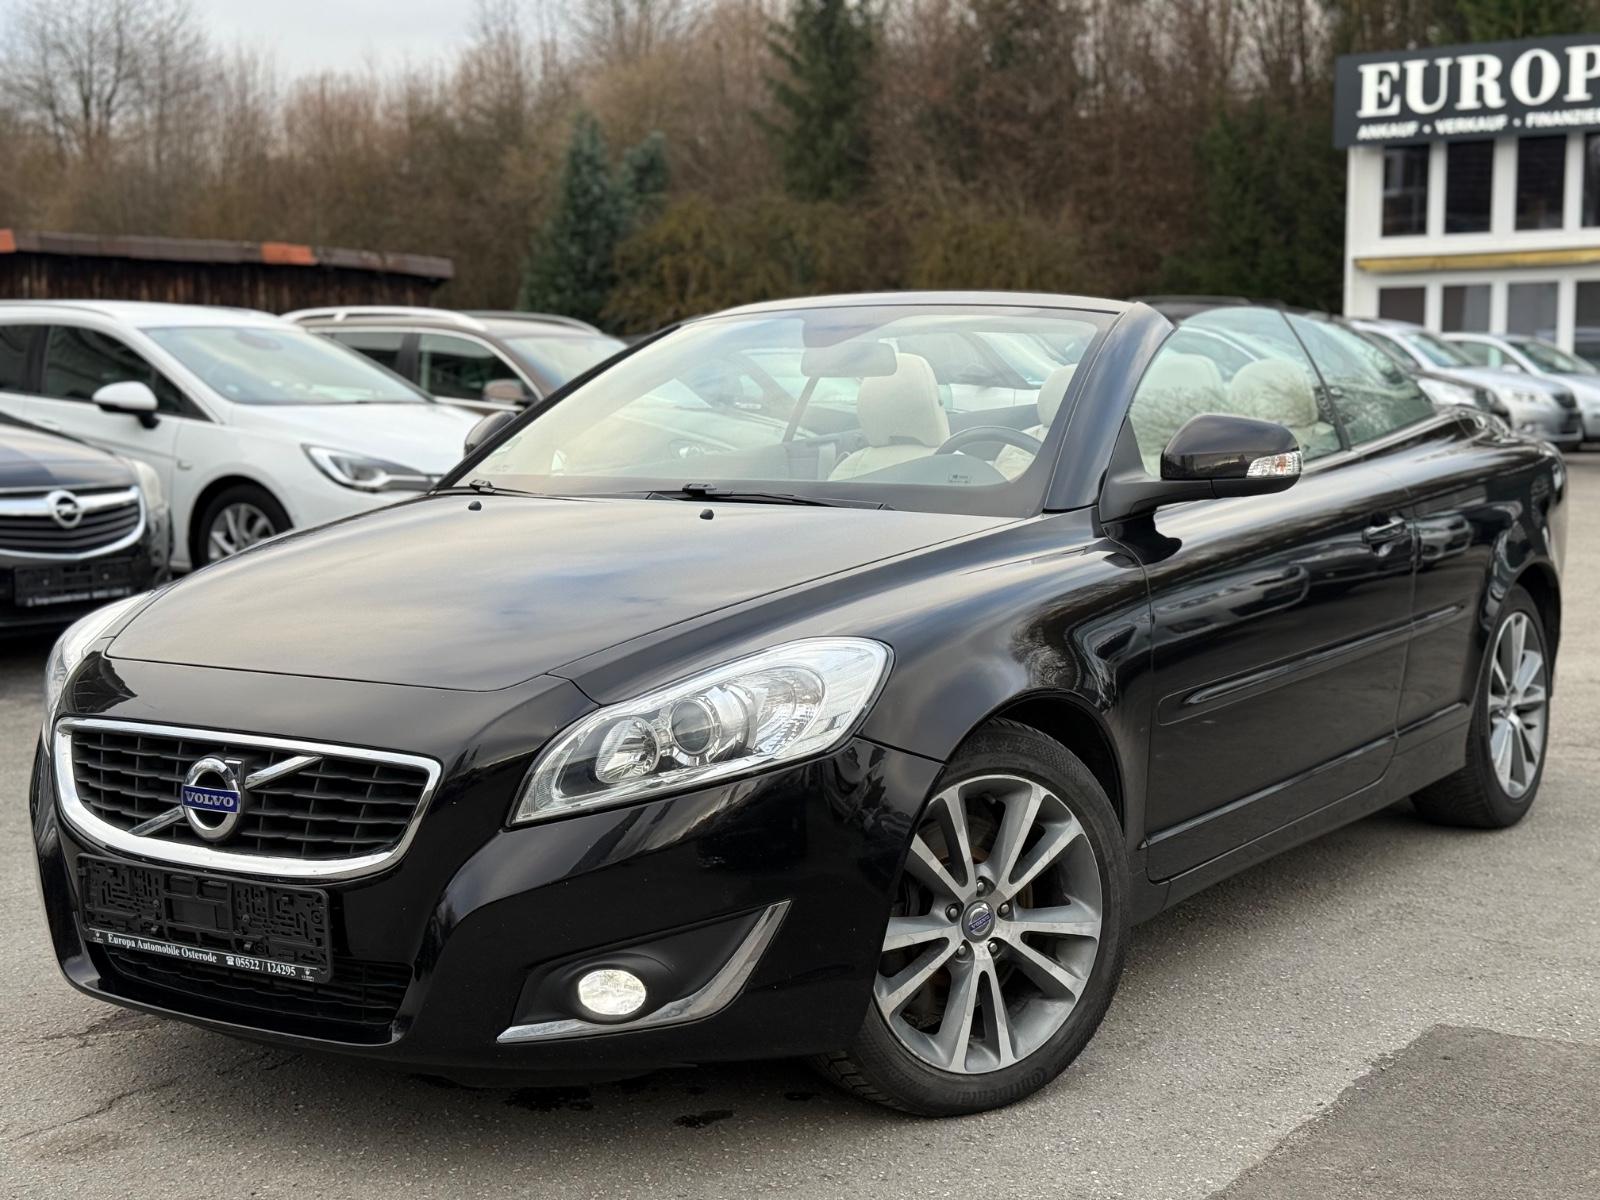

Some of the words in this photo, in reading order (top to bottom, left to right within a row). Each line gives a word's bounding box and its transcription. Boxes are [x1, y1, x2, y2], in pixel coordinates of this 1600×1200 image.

[1356, 44, 1600, 118] EUROP
[1357, 121, 1418, 140] ANKAUF
[1435, 114, 1508, 135] VERKAUF
[185, 791, 234, 807] VOLVO
[107, 933, 136, 949] Europa
[137, 939, 180, 956] Automobile
[181, 947, 217, 963] Osterode
[235, 957, 260, 970] 05522
[267, 962, 296, 977] 124295
